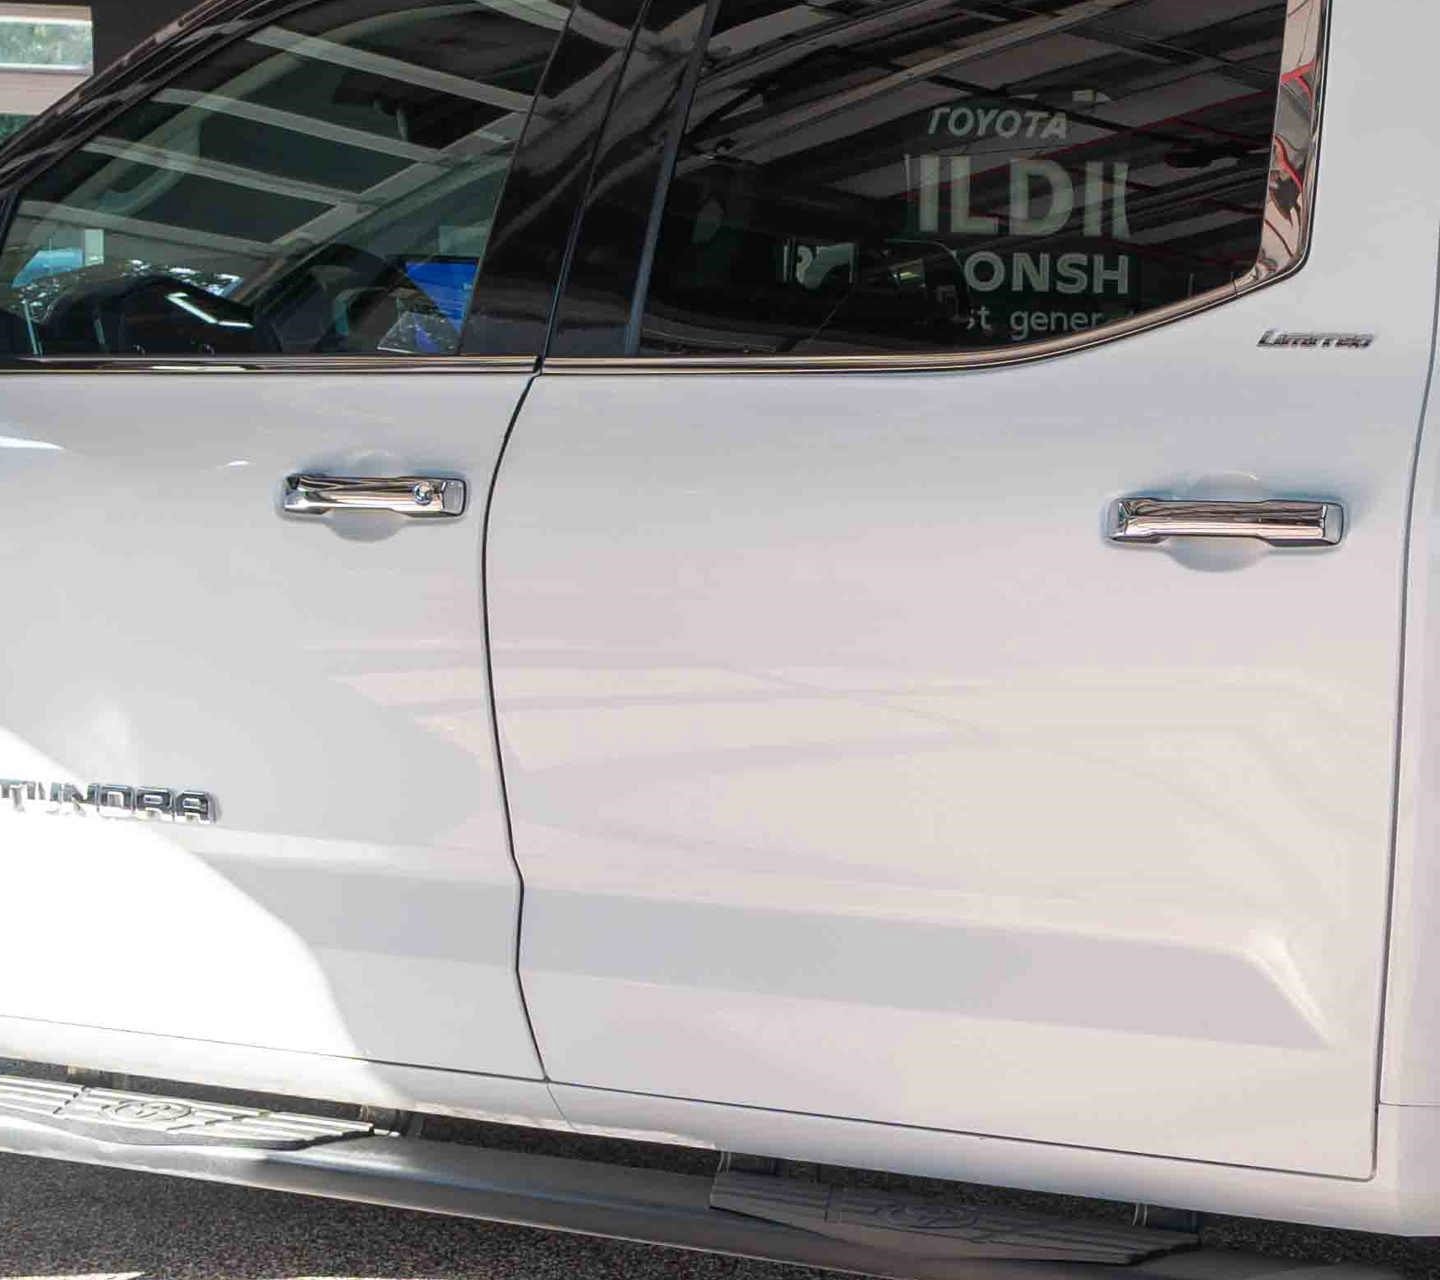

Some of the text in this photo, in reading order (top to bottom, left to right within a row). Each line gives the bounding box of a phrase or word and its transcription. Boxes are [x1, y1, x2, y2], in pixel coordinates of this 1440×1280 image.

[928, 106, 1068, 139] TOYOTA
[963, 250, 1130, 295] ONSH
[1010, 308, 1103, 341] gener
